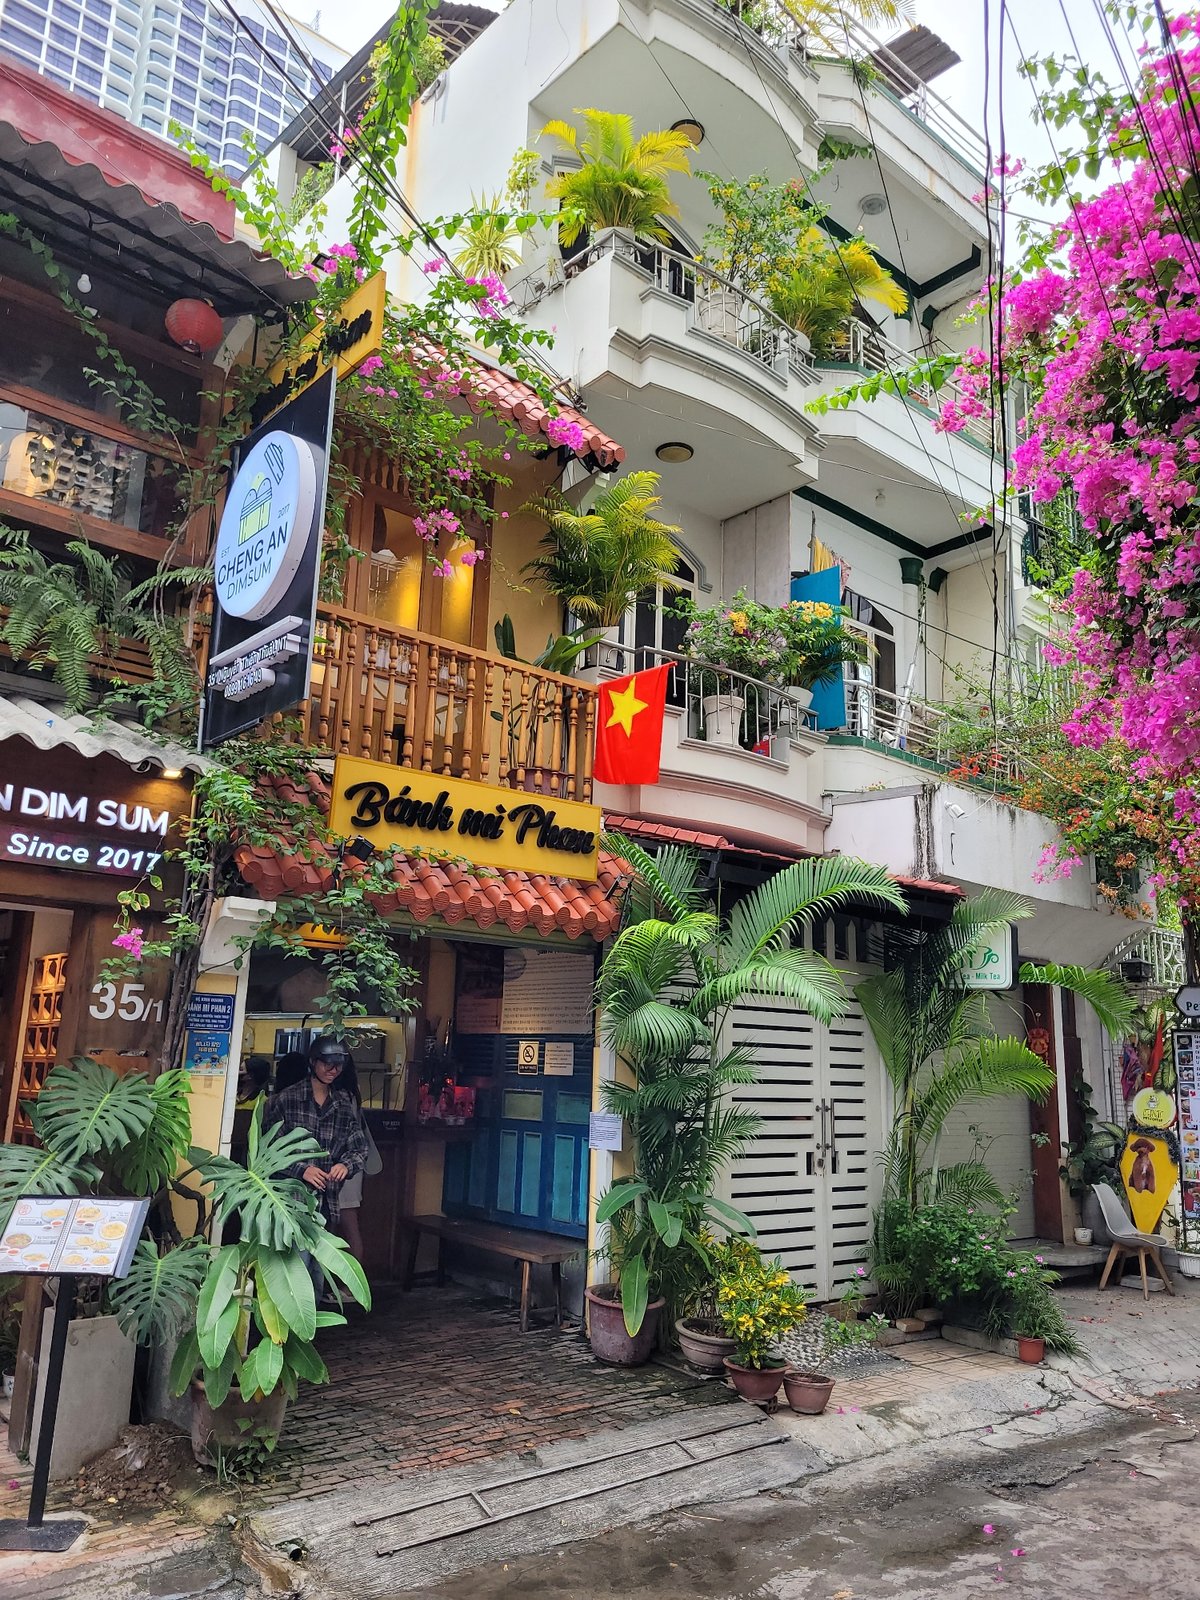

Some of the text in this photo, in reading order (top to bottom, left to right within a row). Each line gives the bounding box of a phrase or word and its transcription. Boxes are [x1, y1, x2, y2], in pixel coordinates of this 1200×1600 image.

[217, 521, 289, 586] CHENG AN
[226, 557, 273, 600] DIMSUM
[20, 786, 88, 823] DIM
[96, 799, 170, 836] SUM
[344, 781, 595, 855] Bánh mì Phan
[7, 832, 162, 873] Since 2017
[975, 972, 987, 980] Milk
[989, 972, 1000, 980] Tea
[89, 982, 164, 1023] 35/1
[210, 1004, 226, 1013] PHAN
[226, 1005, 231, 1014] 2
[1186, 1001, 1200, 1011] Pe
